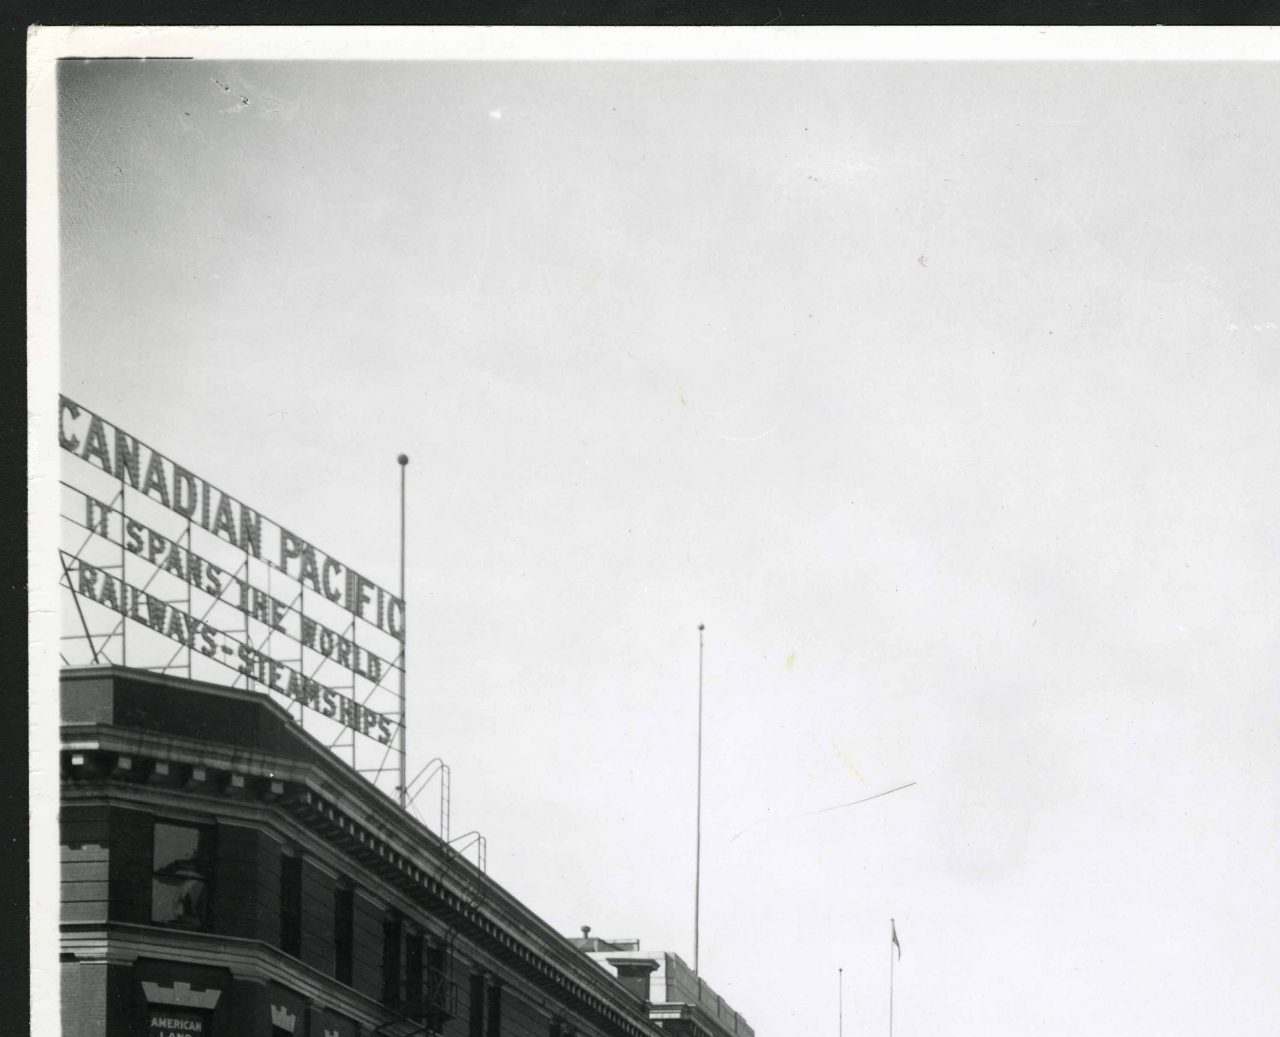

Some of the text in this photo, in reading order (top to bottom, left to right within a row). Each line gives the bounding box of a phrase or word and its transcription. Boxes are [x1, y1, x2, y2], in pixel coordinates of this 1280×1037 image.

[59, 396, 405, 640] CANADIAN PACIFIC
[86, 495, 381, 684] IT SPANS THE WORLD
[151, 1018, 202, 1032] AMERICAN
